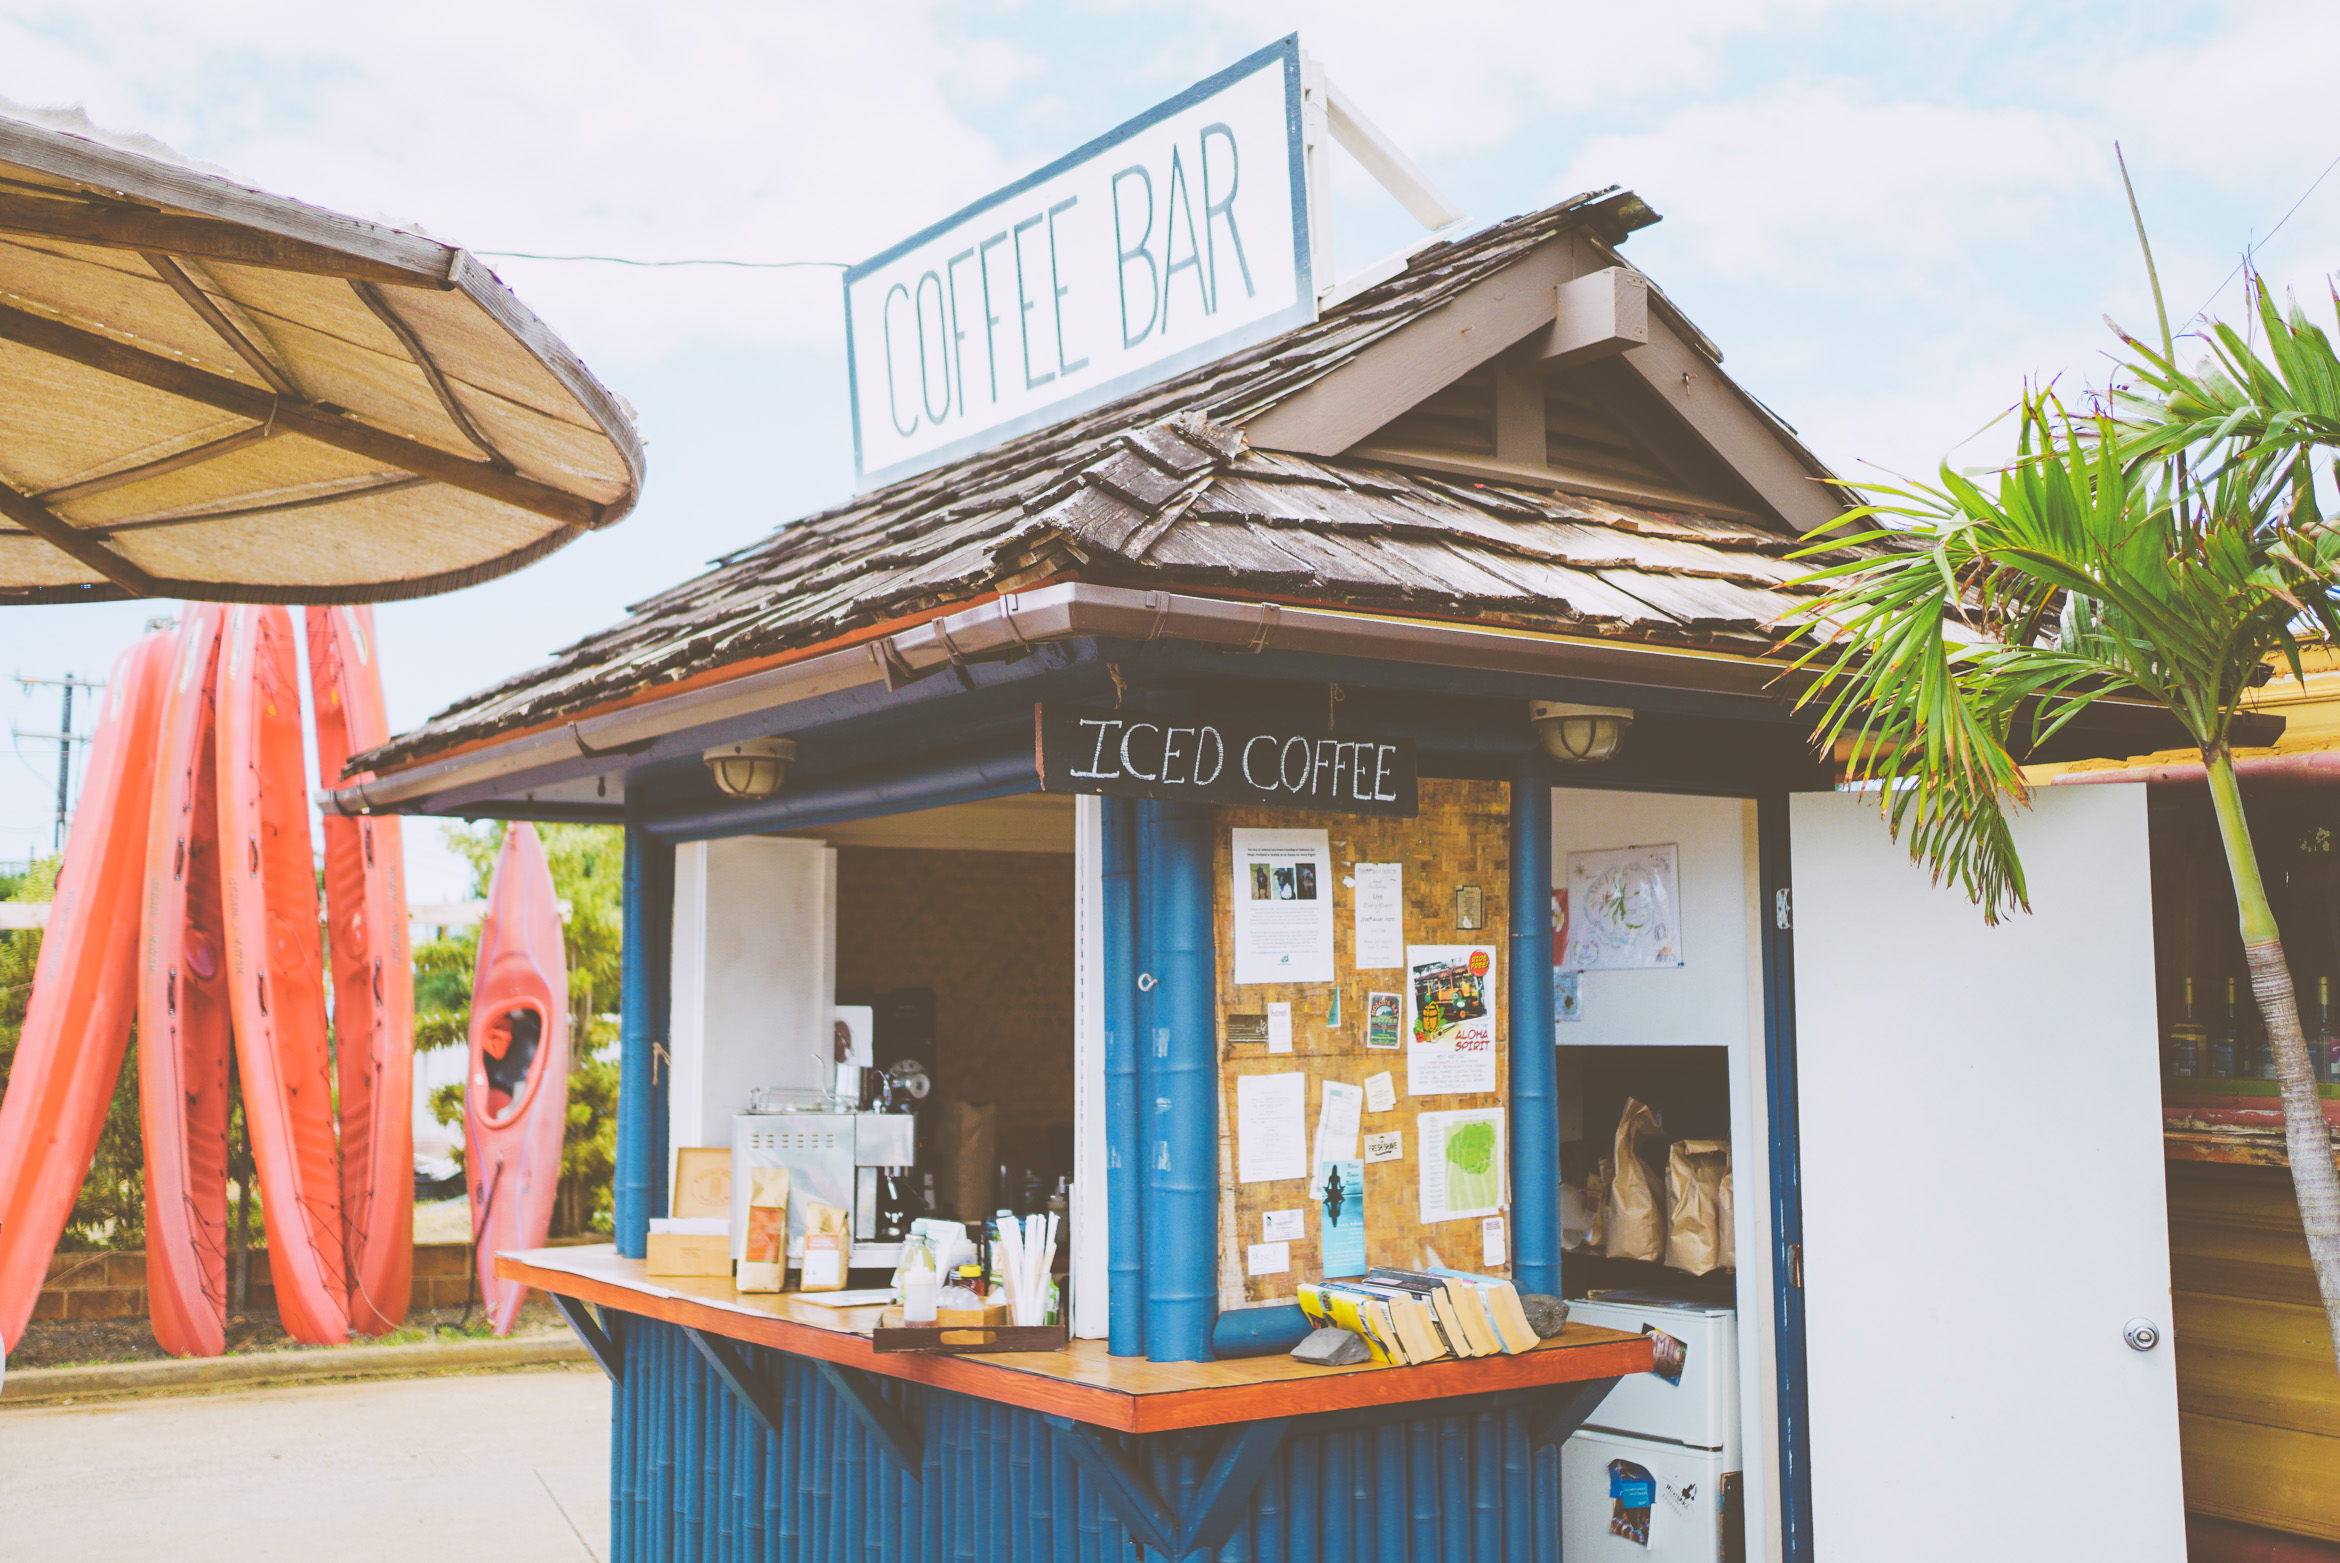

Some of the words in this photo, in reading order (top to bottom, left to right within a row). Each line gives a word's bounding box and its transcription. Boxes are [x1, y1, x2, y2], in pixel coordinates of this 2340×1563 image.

[884, 194, 1089, 438] COFFEE
[1112, 121, 1256, 351] BAR
[1070, 718, 1225, 787] ICED
[1242, 735, 1397, 802] COFFEE
[1455, 1029, 1488, 1040] ALOHA
[1455, 1041, 1490, 1052] SPIRIT
